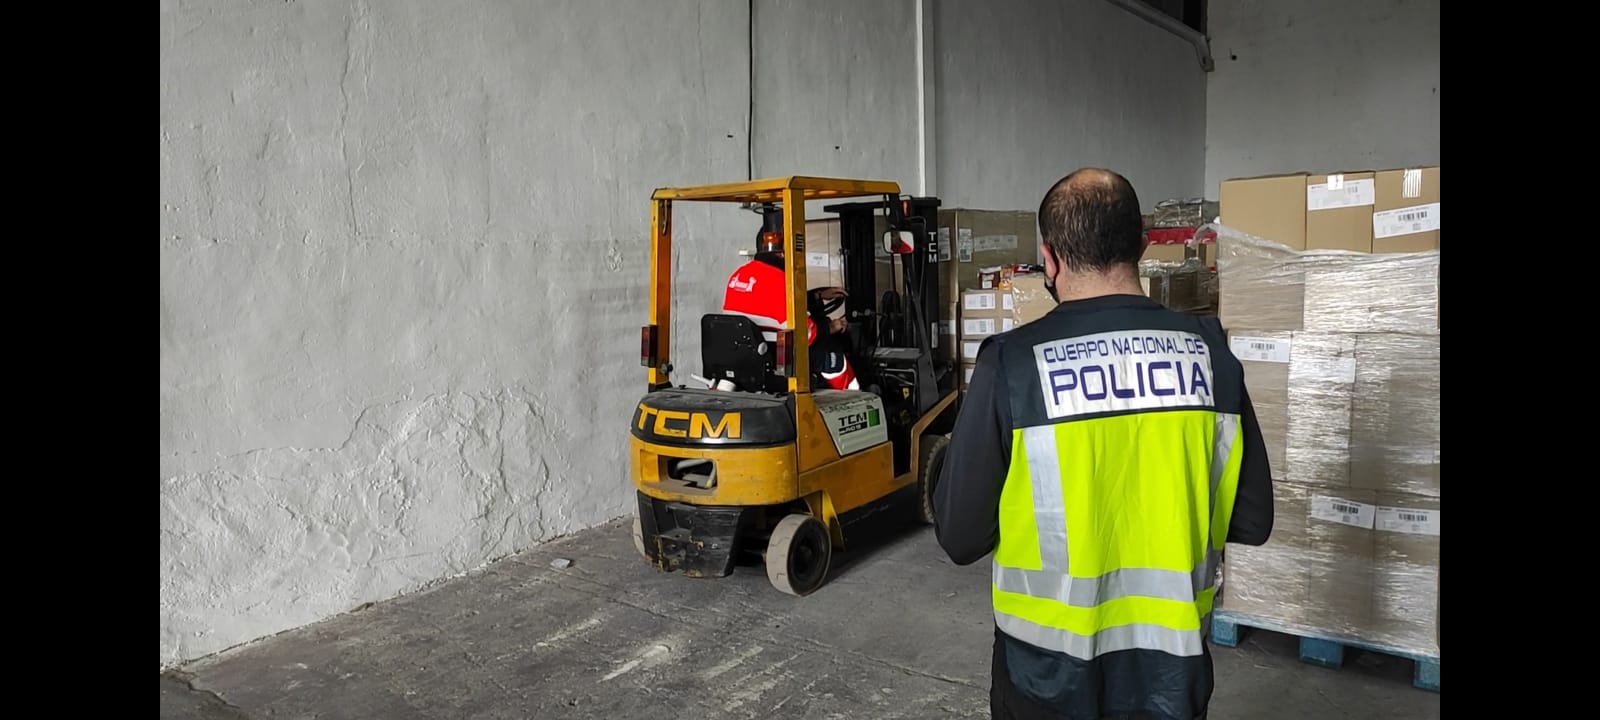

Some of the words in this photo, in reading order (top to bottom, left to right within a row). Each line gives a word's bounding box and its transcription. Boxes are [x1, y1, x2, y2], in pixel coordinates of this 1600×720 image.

[928, 231, 937, 263] TCM
[1043, 339, 1109, 363] CUERPO
[1112, 336, 1185, 356] NACIONAL
[1185, 338, 1206, 355] DE
[1048, 361, 1210, 405] POLICIA
[638, 402, 741, 439] TCM
[838, 411, 867, 427] TCM
